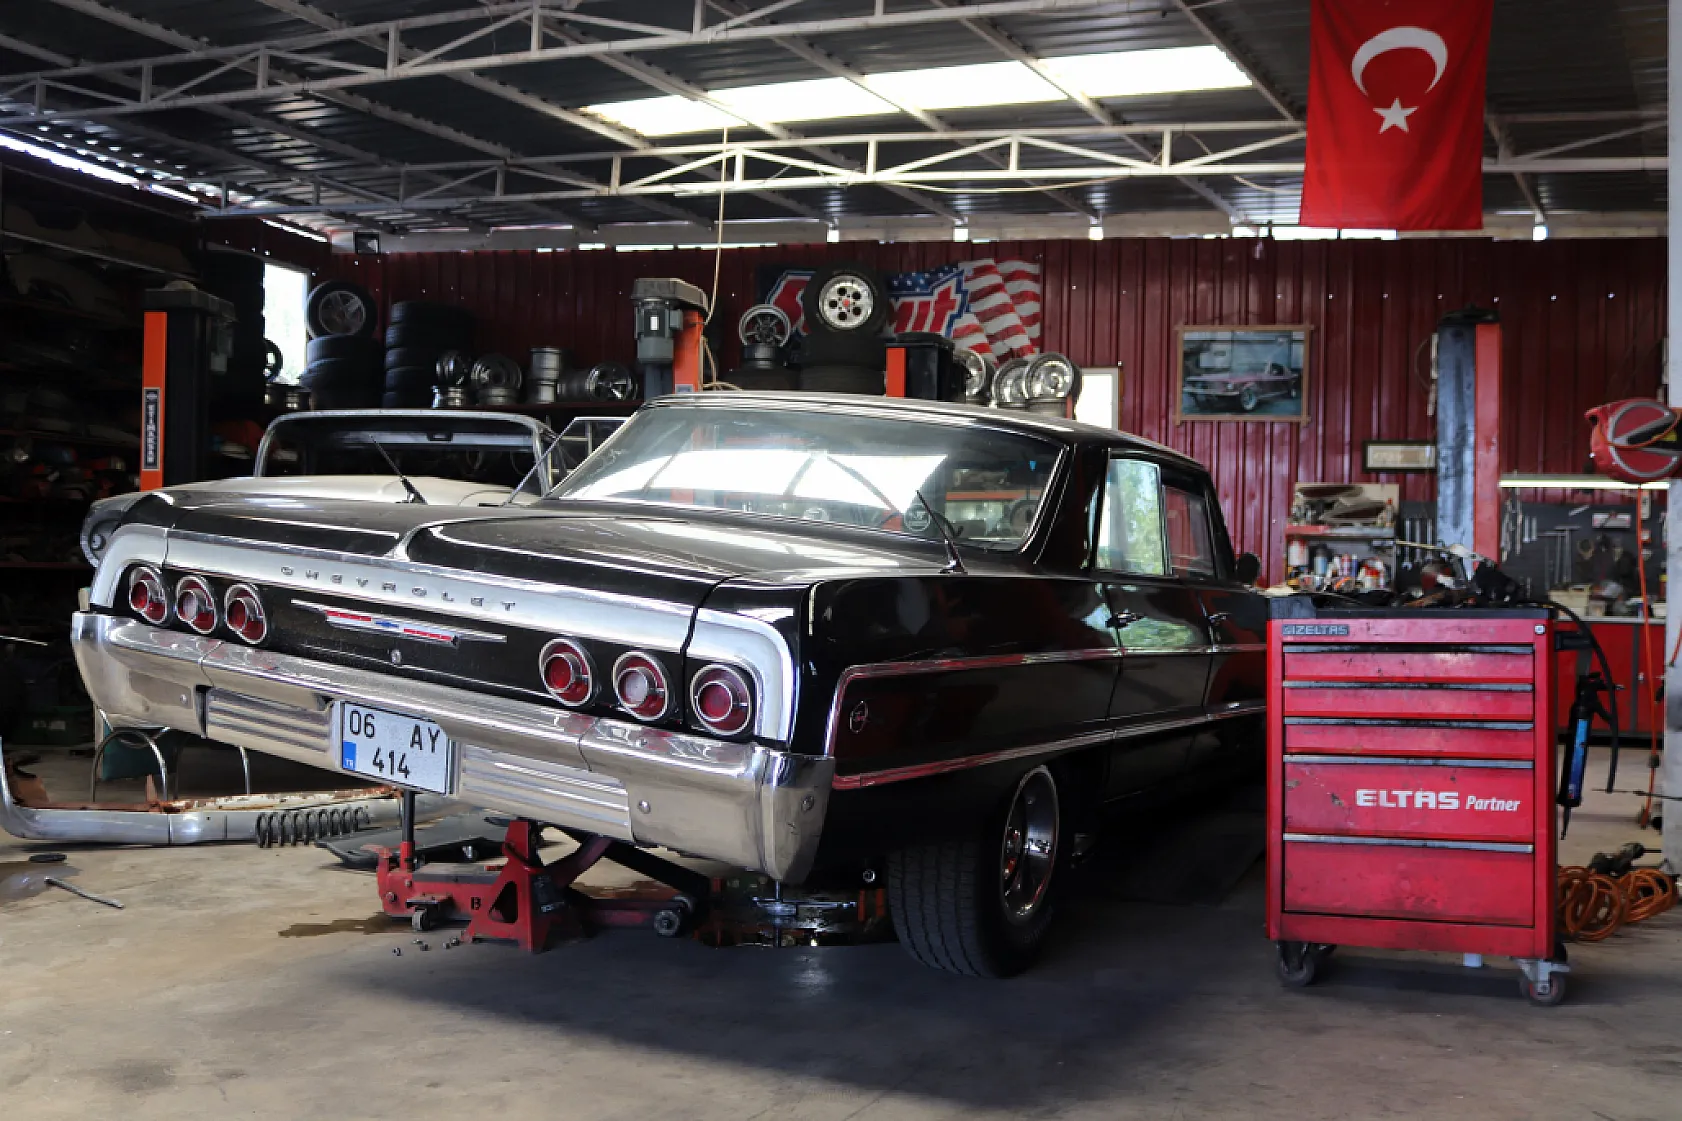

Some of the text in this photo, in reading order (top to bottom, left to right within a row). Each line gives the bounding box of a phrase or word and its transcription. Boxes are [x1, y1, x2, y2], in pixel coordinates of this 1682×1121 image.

[280, 566, 516, 611] CHEVROLET
[349, 708, 441, 754] 06 AY
[372, 746, 411, 779] 414
[1465, 794, 1522, 812] Partner
